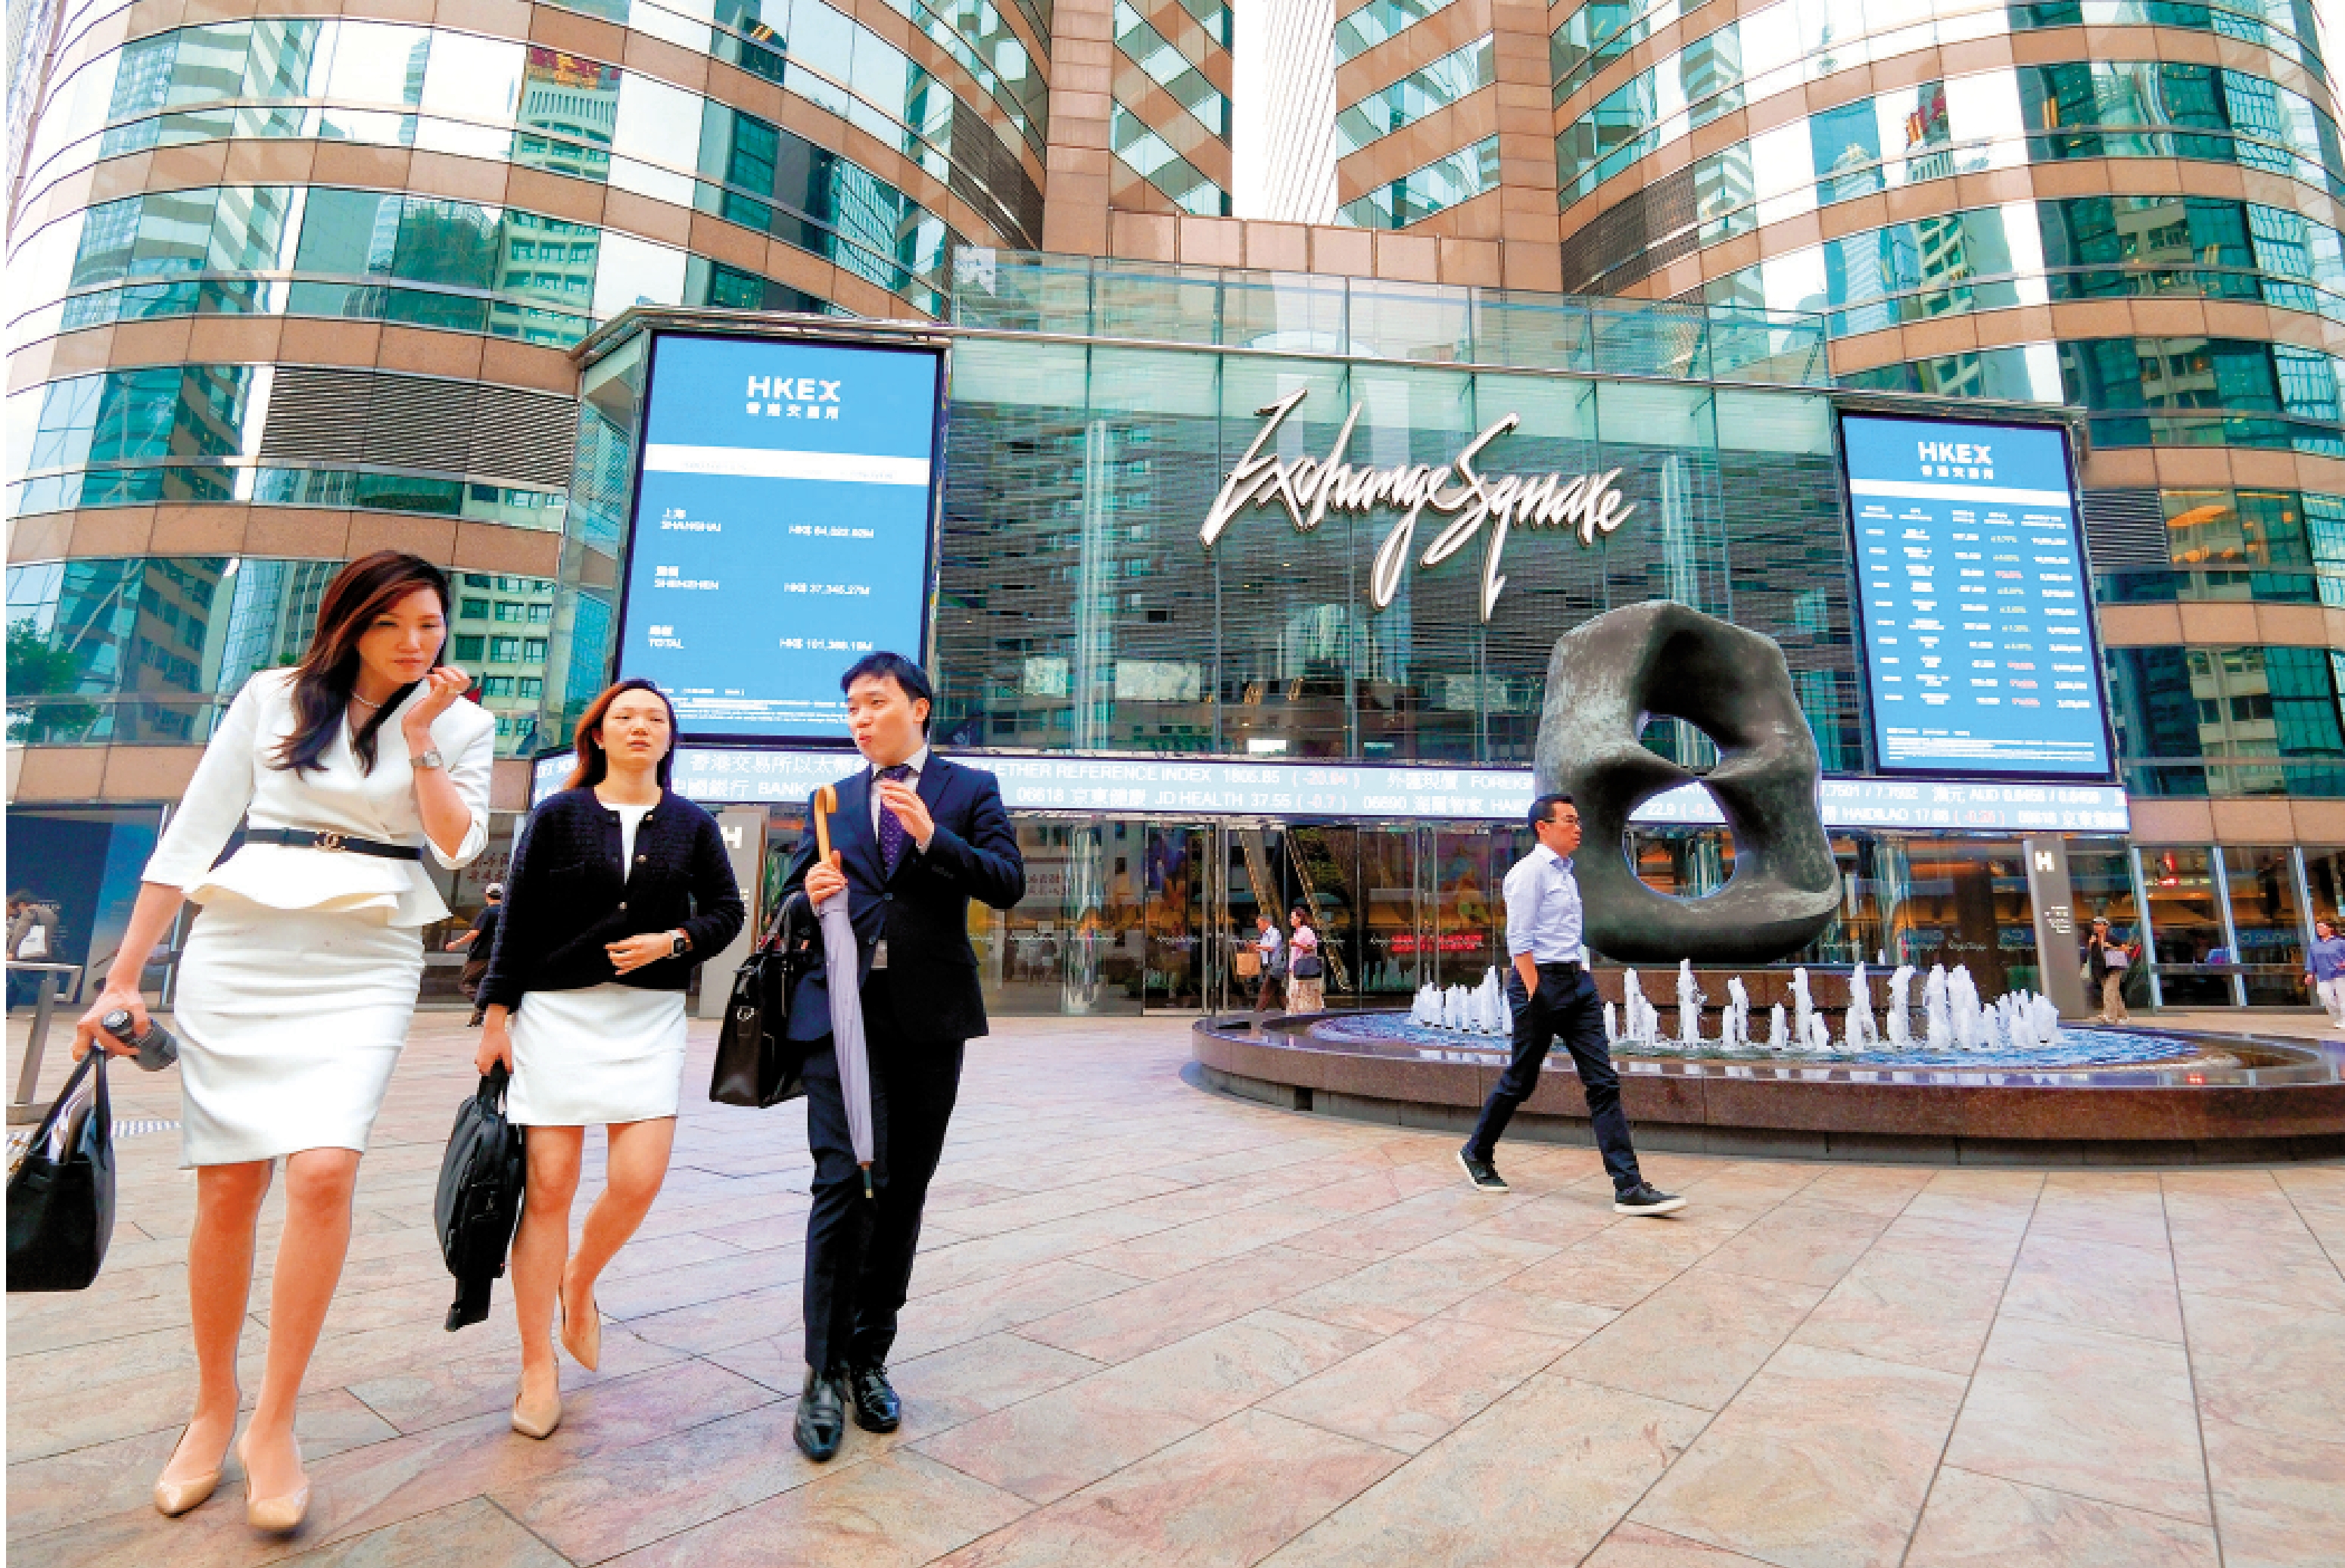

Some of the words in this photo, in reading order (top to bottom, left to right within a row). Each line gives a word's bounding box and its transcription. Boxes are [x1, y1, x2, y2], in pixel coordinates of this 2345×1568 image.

[746, 376, 840, 402] HKEX
[1917, 441, 1993, 465] HKEX
[1200, 387, 1461, 611] Exchange
[1420, 412, 1636, 623] Square
[995, 763, 1051, 778] ETHER
[1057, 764, 1158, 780] REFERENCE
[1162, 767, 1211, 782] INDEX
[1471, 774, 1534, 790] FOREIG
[758, 782, 808, 798] BANK
[1155, 791, 1174, 805] JD
[1179, 792, 1243, 807] HEALTH
